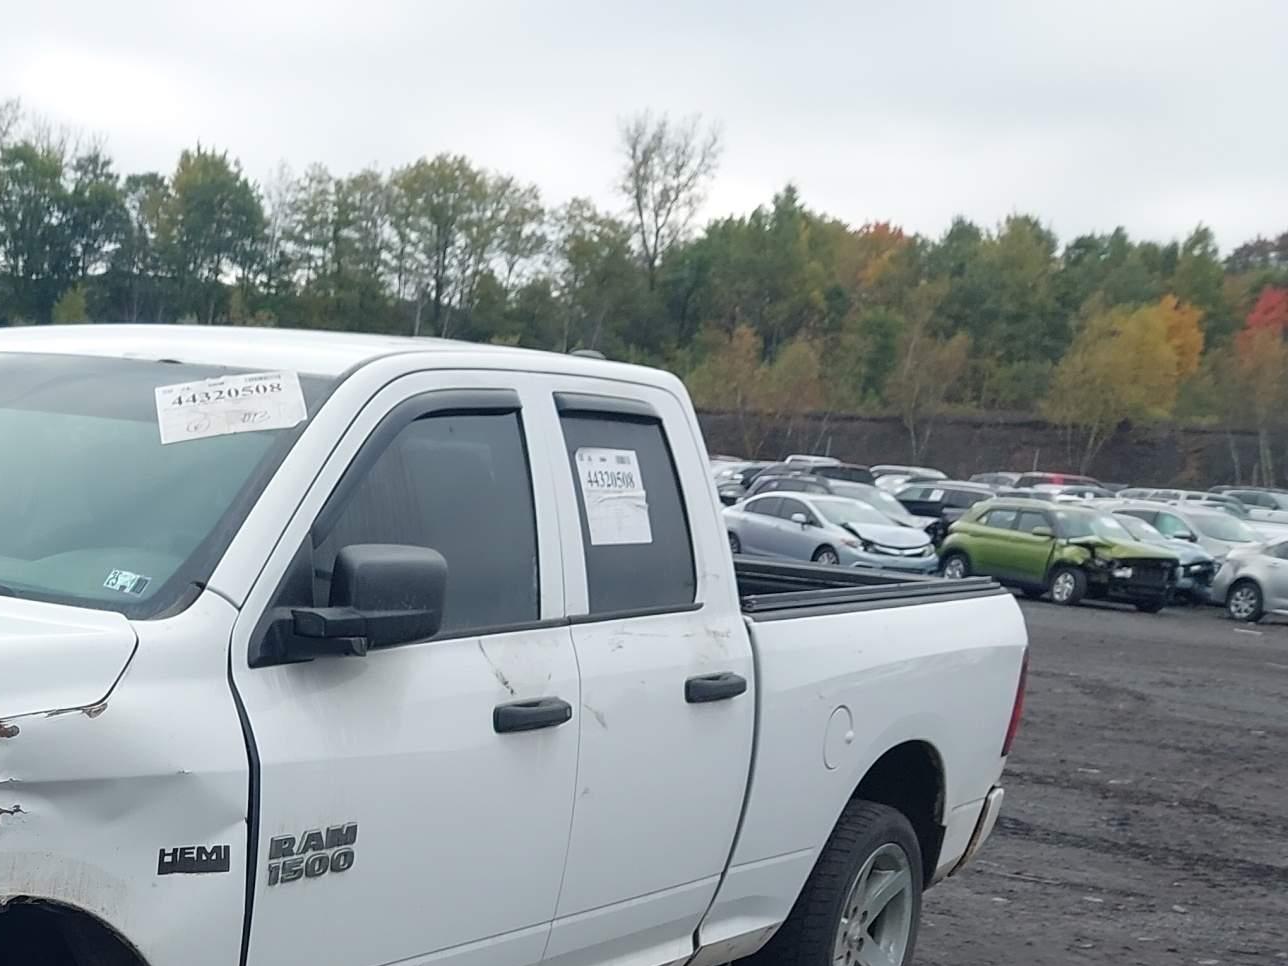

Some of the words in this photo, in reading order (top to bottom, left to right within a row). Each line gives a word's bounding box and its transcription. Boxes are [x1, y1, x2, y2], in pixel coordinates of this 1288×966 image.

[171, 382, 283, 407] 44320508
[158, 845, 230, 866] HEMI
[269, 822, 358, 860] RAM
[268, 847, 355, 887] 1500
